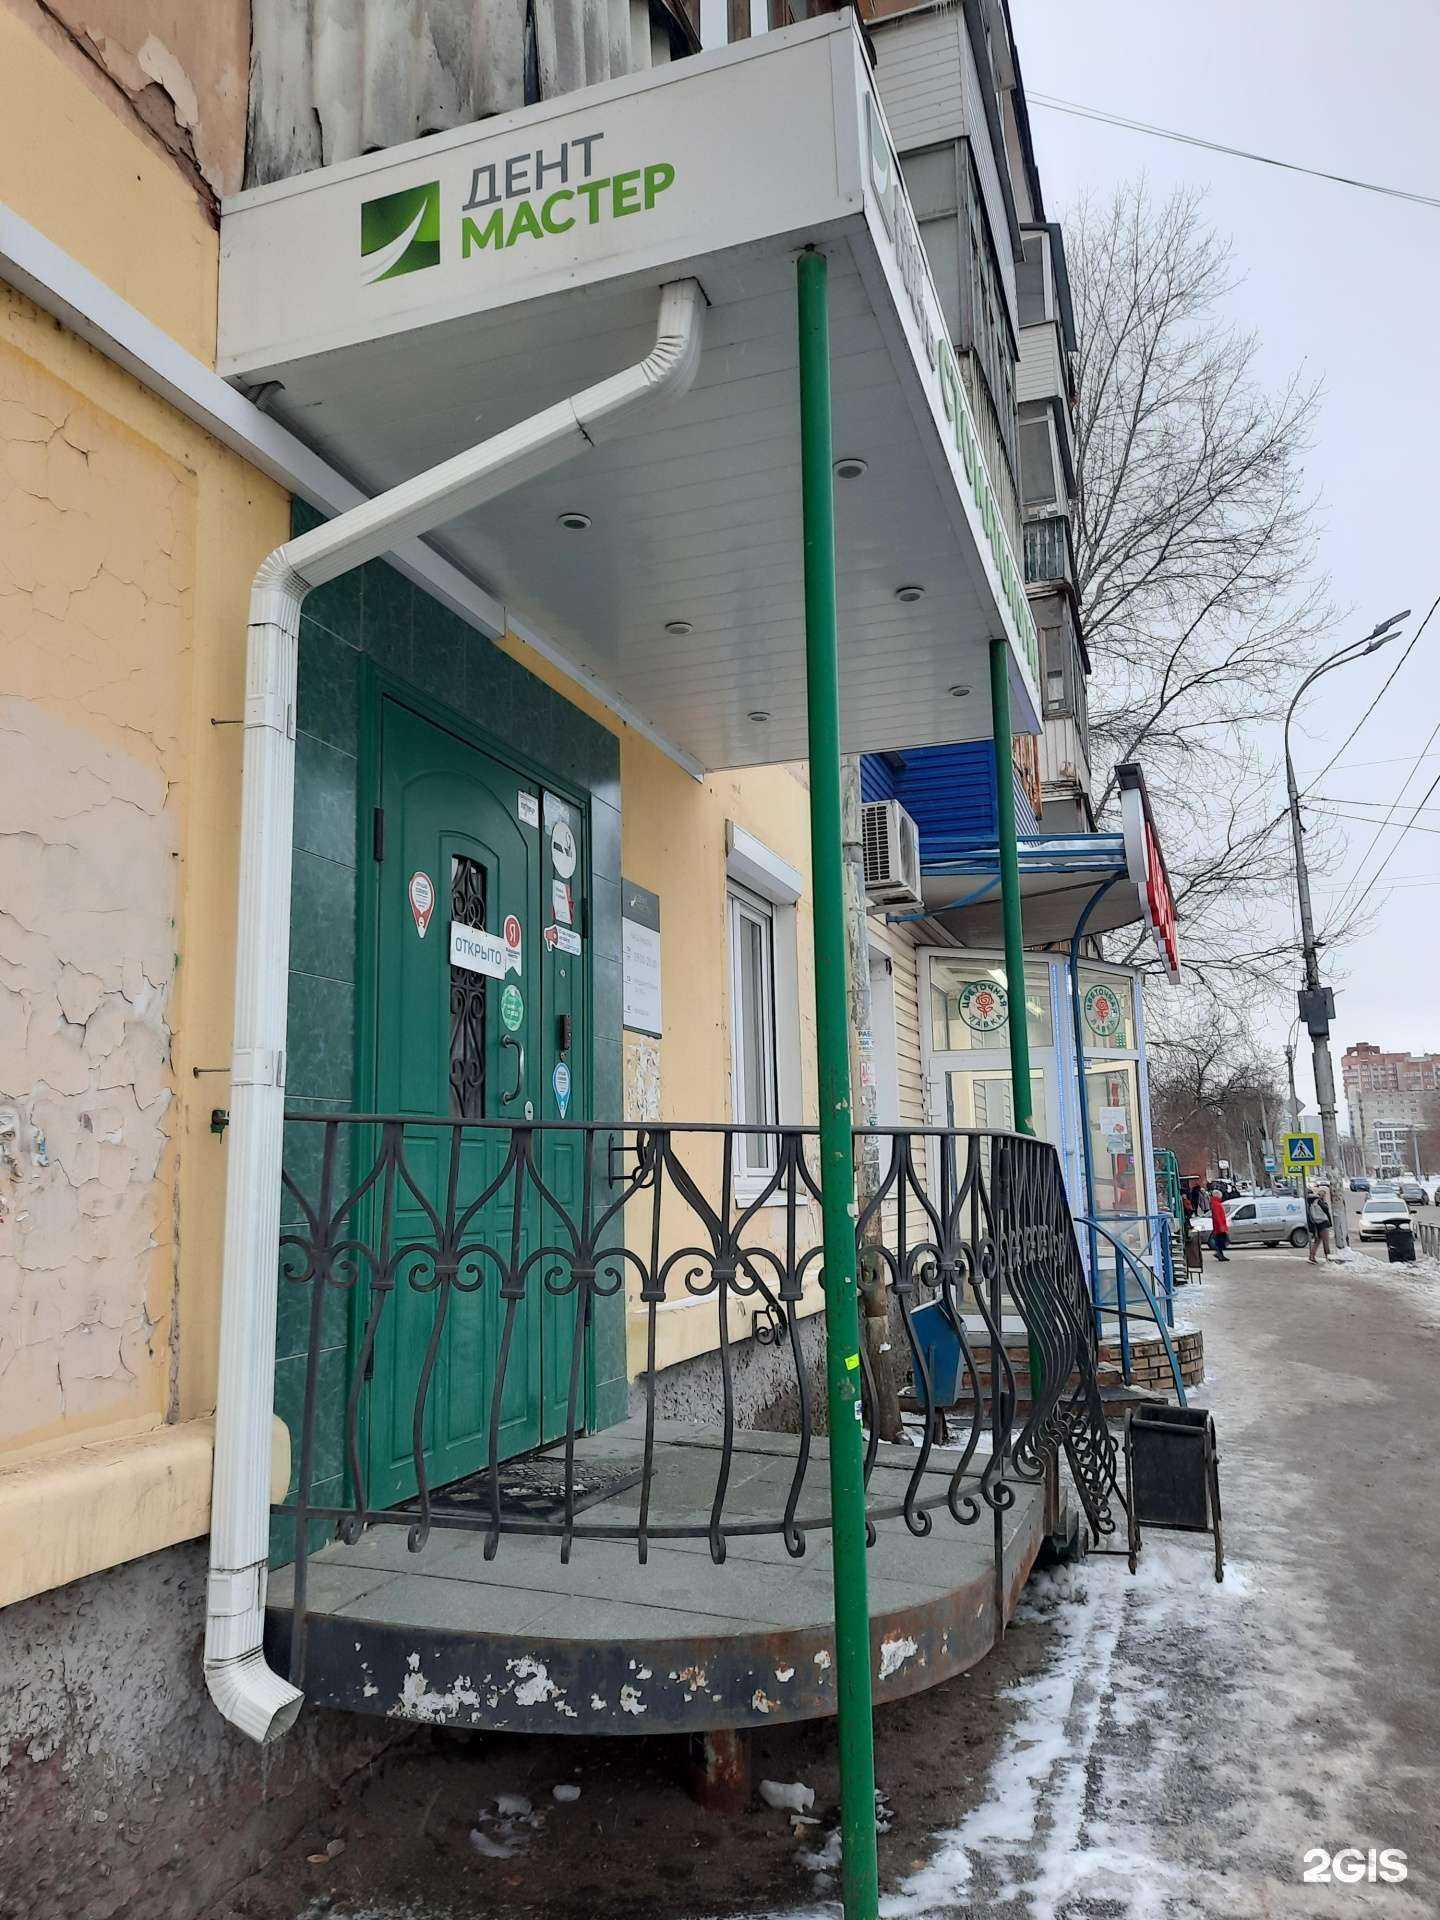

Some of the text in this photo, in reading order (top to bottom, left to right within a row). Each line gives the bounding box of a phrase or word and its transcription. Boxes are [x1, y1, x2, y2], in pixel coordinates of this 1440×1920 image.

[462, 131, 604, 211] ДЕНТ
[462, 162, 676, 259] МАСТЕР
[455, 937, 502, 965] ОТКРЫТО
[961, 983, 1008, 1009] ЦВЕТОЧНАЯ
[968, 1014, 1003, 1029] ЛАВКА
